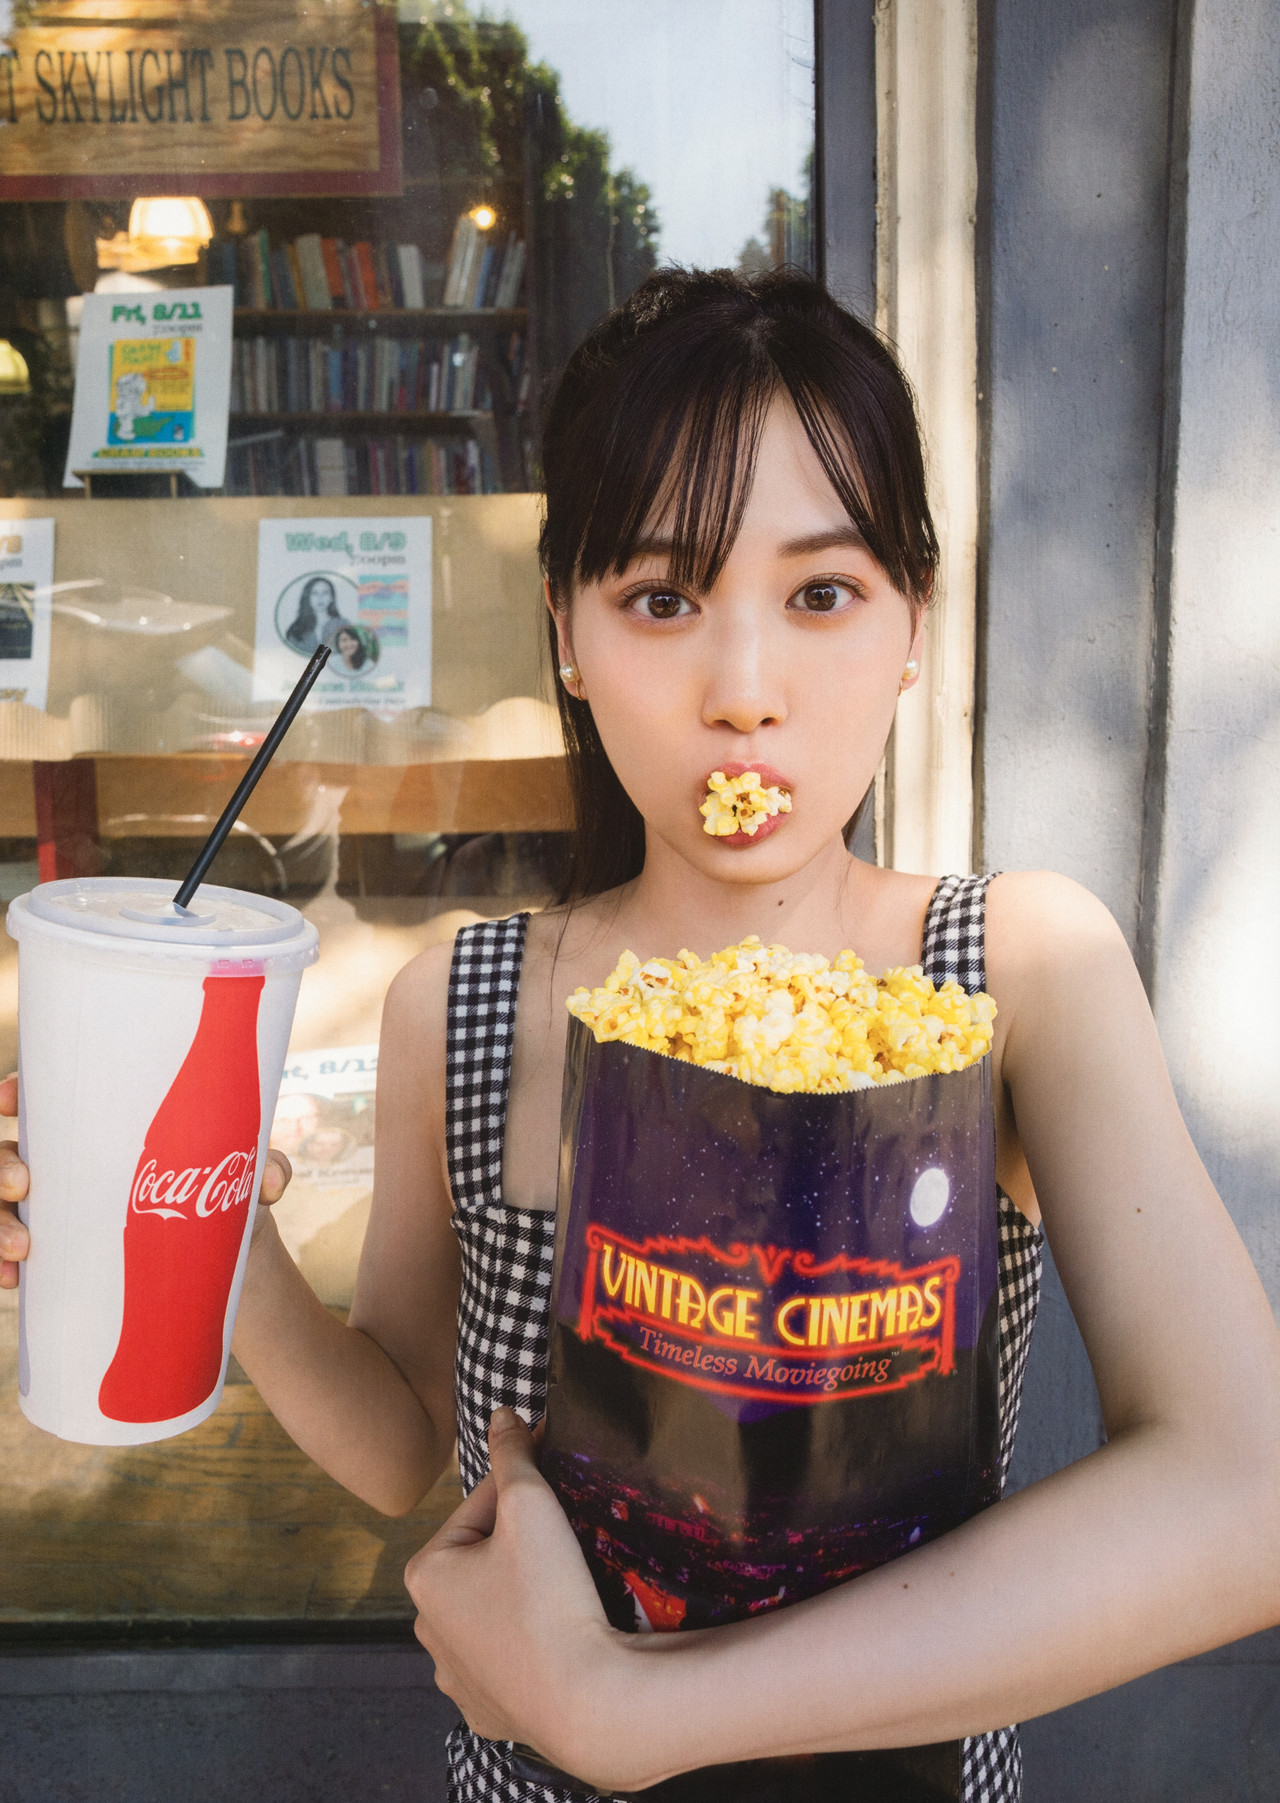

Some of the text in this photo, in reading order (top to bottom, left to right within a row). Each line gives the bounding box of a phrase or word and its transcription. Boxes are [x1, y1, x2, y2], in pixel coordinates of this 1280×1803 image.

[34, 47, 214, 124] SKYLIGHT
[226, 46, 356, 121] BOOKS
[153, 302, 202, 320] 8/11
[285, 531, 406, 558] Wed, 8/9
[132, 1146, 256, 1221] Coca-Cola
[602, 1243, 942, 1347] VINTAGE CINEMAS
[639, 1326, 737, 1376] Timeless
[743, 1354, 892, 1391] Moviegoing
